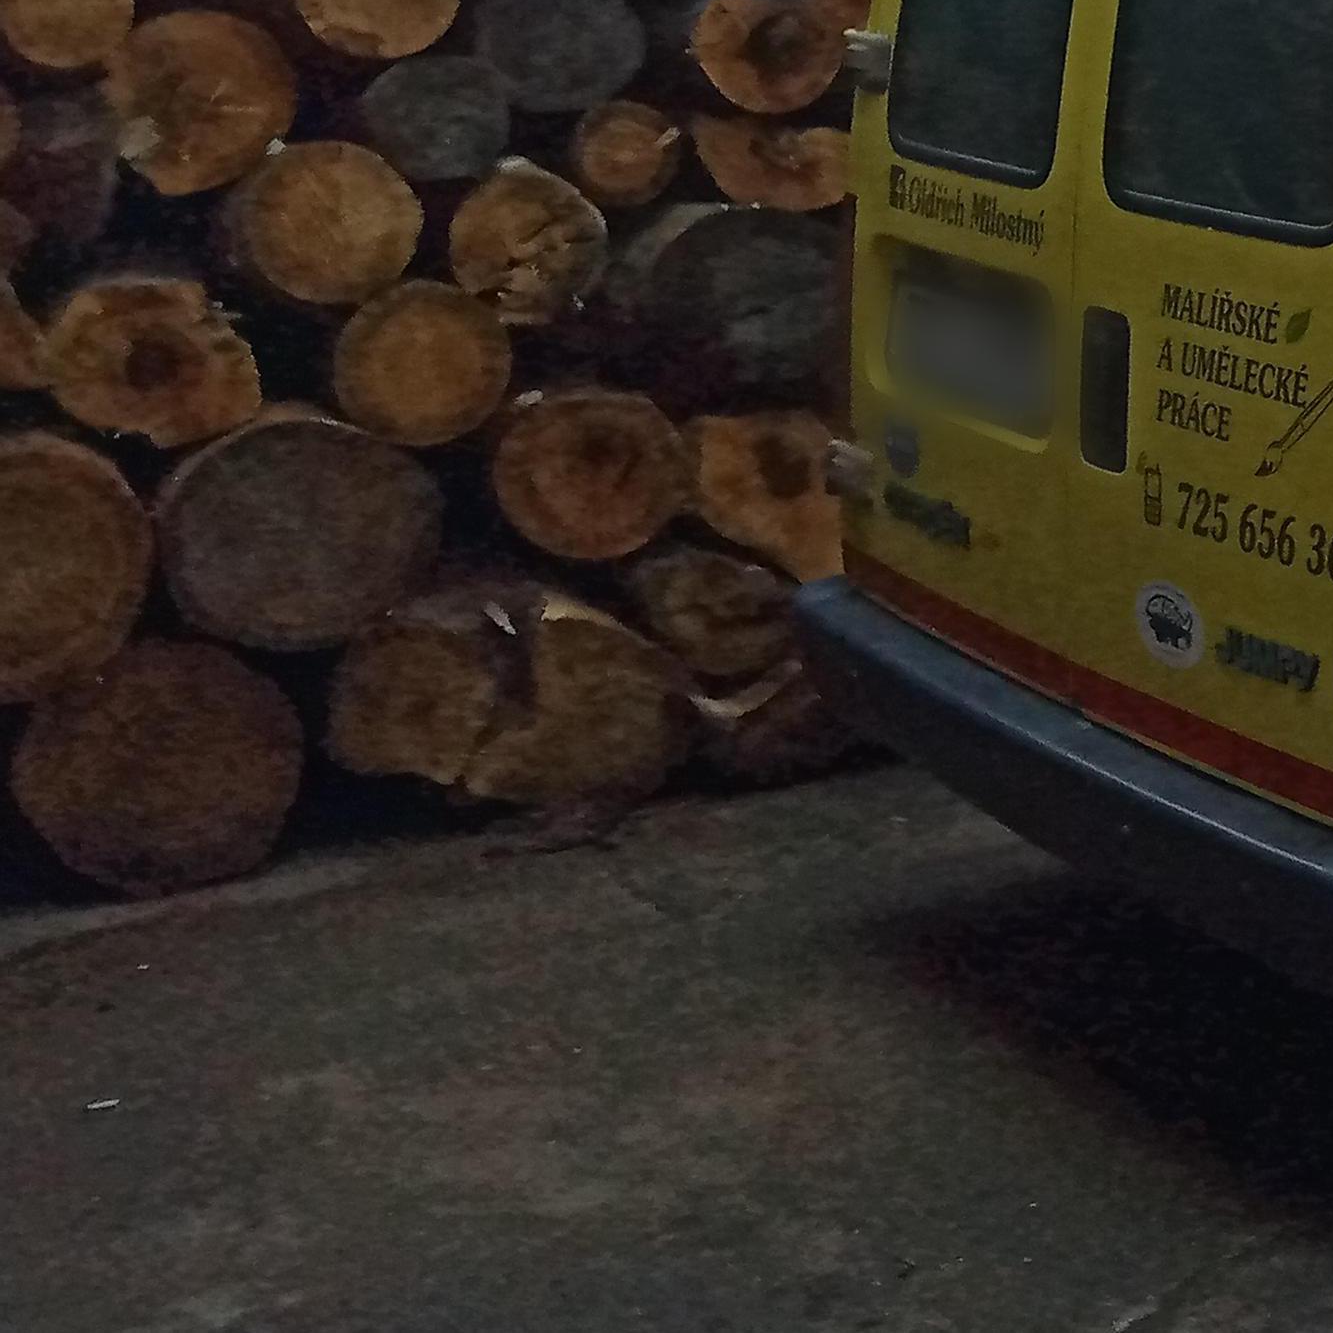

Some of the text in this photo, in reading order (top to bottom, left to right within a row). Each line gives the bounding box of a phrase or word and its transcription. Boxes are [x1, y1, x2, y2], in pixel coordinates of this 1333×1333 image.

[1161, 283, 1281, 344] MALÍŘSKÉ
[1156, 336, 1310, 408] A UMĚLECKÉ
[1156, 388, 1233, 441] PRÁCE
[1176, 481, 1229, 543] 725
[1239, 502, 1296, 567] 656
